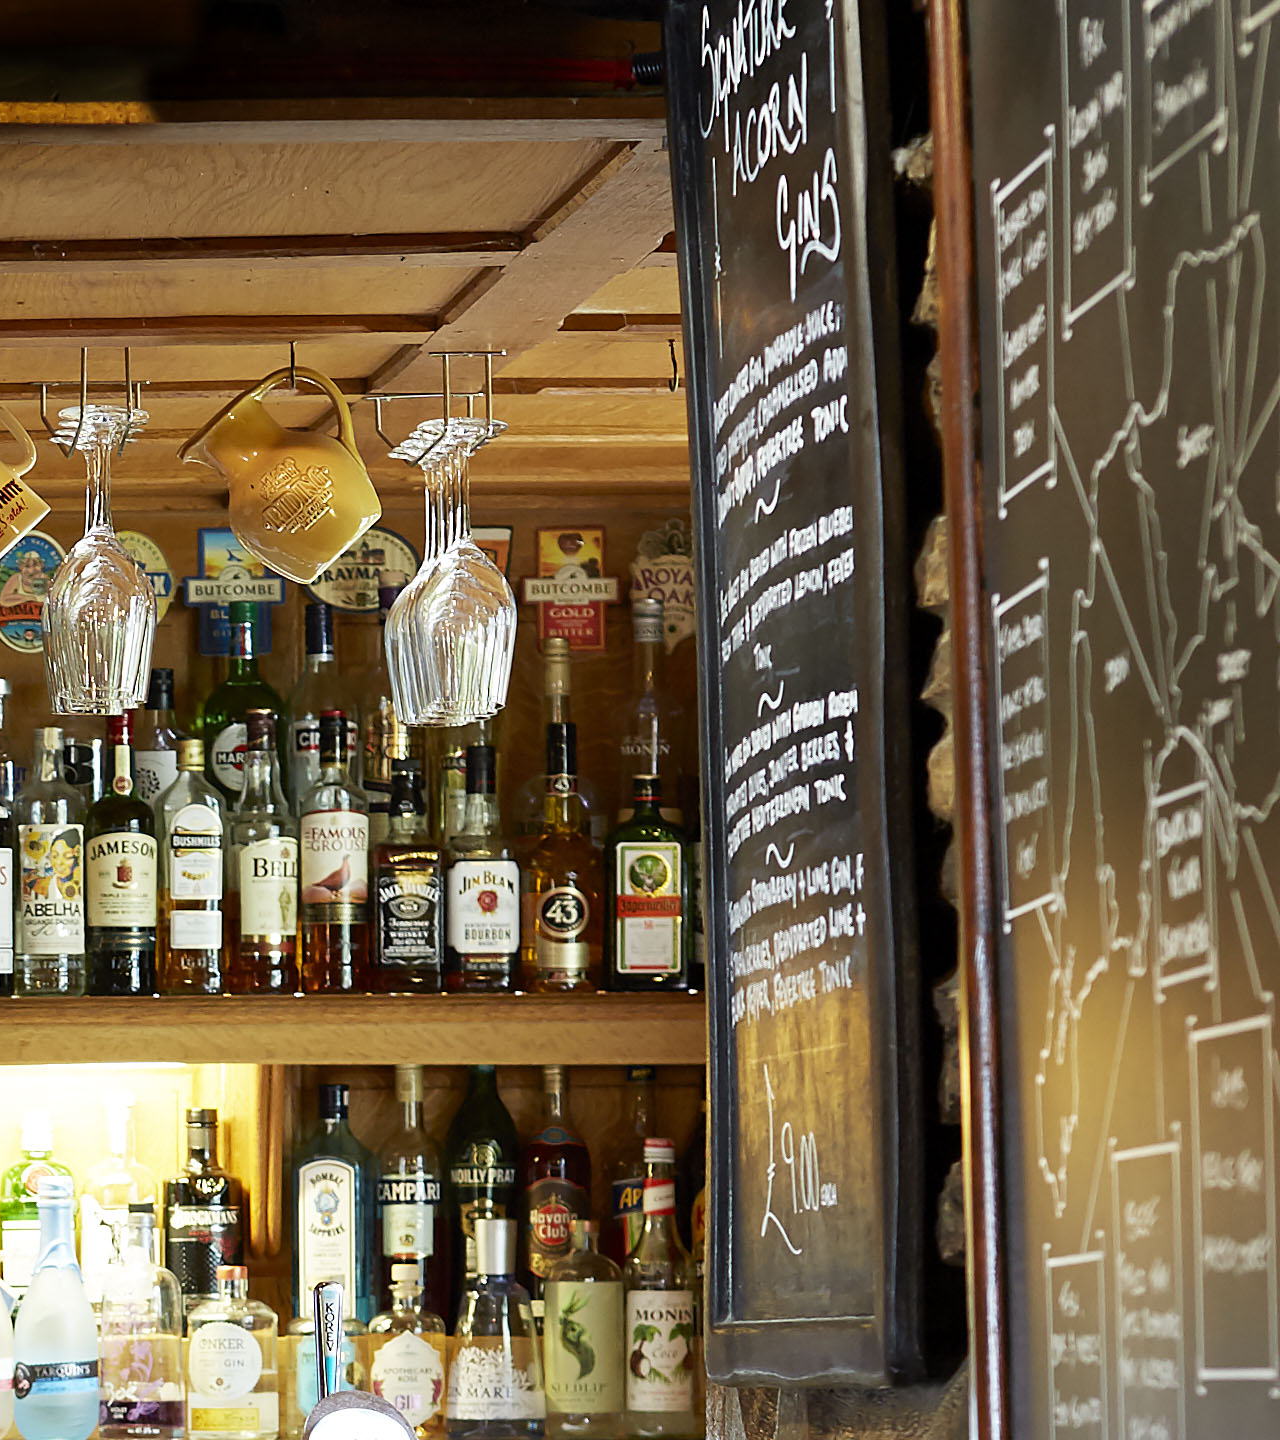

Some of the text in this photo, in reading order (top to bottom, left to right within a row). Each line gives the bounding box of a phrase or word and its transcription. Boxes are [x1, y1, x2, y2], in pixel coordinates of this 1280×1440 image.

[732, 51, 809, 198] ACORN
[776, 147, 842, 303] GINS
[810, 394, 850, 444] TONIC
[640, 567, 696, 588] ROYA
[194, 583, 276, 598] BUTCOMBE
[530, 581, 611, 595] BUTCOMBE
[549, 607, 595, 620] GOLD
[548, 626, 594, 638] BITTER
[771, 708, 792, 745] WITH
[813, 773, 847, 805] TONIC
[172, 835, 220, 848] BUSHMILLS
[311, 826, 367, 841] FAMOUS
[90, 839, 156, 862] JAMESON
[311, 840, 368, 852] GROUSE
[459, 873, 481, 896] JIM
[805, 861, 830, 898] LIME
[23, 903, 82, 918] ABELHA
[546, 900, 579, 924] 43
[827, 901, 856, 939] LIME
[464, 928, 512, 941] BOURBON
[817, 953, 853, 995] TONIC
[450, 1168, 516, 1184] NOILLY PRAT
[377, 1181, 441, 1201] CAMPARI
[529, 1208, 579, 1226] Havana
[538, 1224, 569, 1240] Club
[635, 1308, 694, 1323] MONIN
[325, 1302, 336, 1352] KOREV
[35, 1363, 92, 1380] TARQUIN'S
[223, 1360, 246, 1368] GIN
[466, 1386, 513, 1399] MARE
